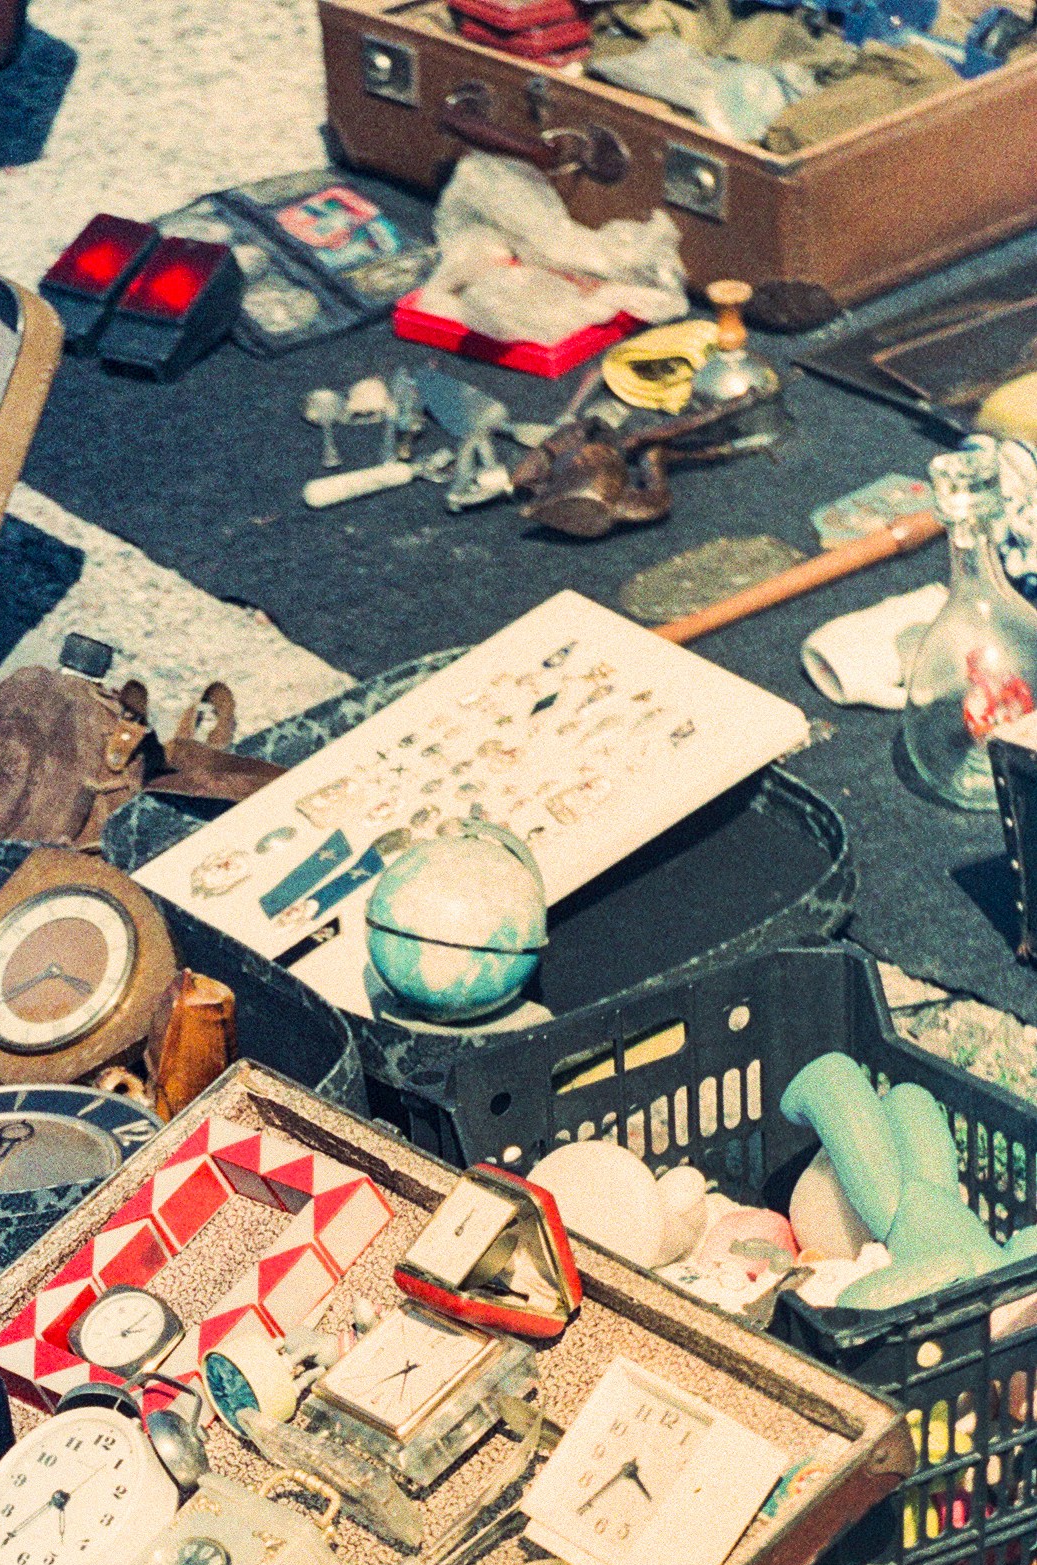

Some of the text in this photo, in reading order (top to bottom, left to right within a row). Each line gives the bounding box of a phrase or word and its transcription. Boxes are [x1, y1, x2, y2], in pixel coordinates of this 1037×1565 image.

[635, 1404, 653, 1422] 11
[659, 1410, 680, 1430] 12
[65, 1436, 83, 1452] 11
[93, 1434, 116, 1451] 12
[36, 1451, 58, 1467] 10
[113, 1458, 124, 1470] 1
[12, 1473, 27, 1487] 9
[112, 1484, 127, 1500] 2
[99, 1512, 115, 1527] 3
[16, 1552, 30, 1565] 6
